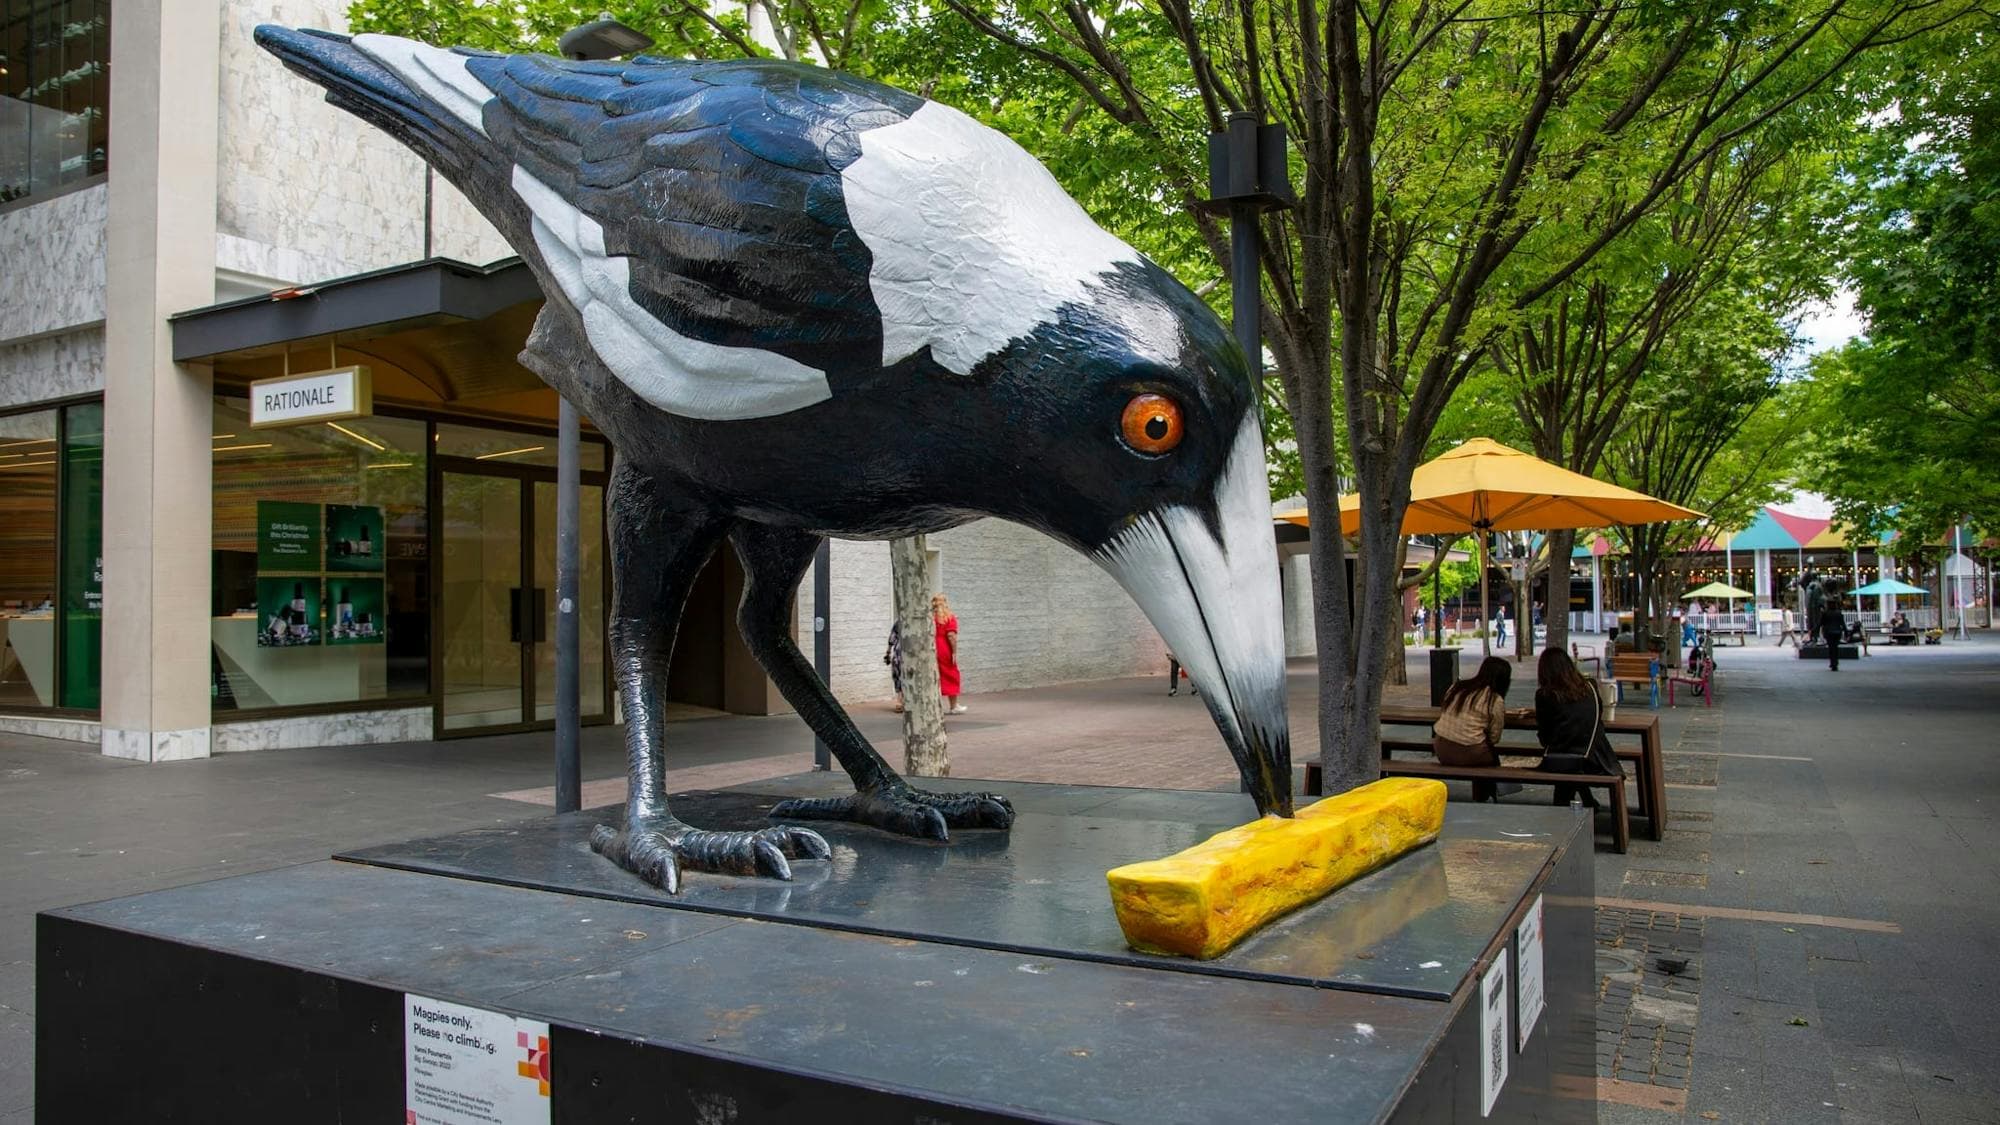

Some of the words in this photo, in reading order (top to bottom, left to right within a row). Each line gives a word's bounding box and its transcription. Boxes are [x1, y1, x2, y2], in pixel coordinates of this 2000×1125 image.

[265, 386, 335, 412] RATIONALE
[414, 1005, 450, 1023] Magpies
[451, 1016, 472, 1030] only.
[414, 1023, 440, 1039] Please
